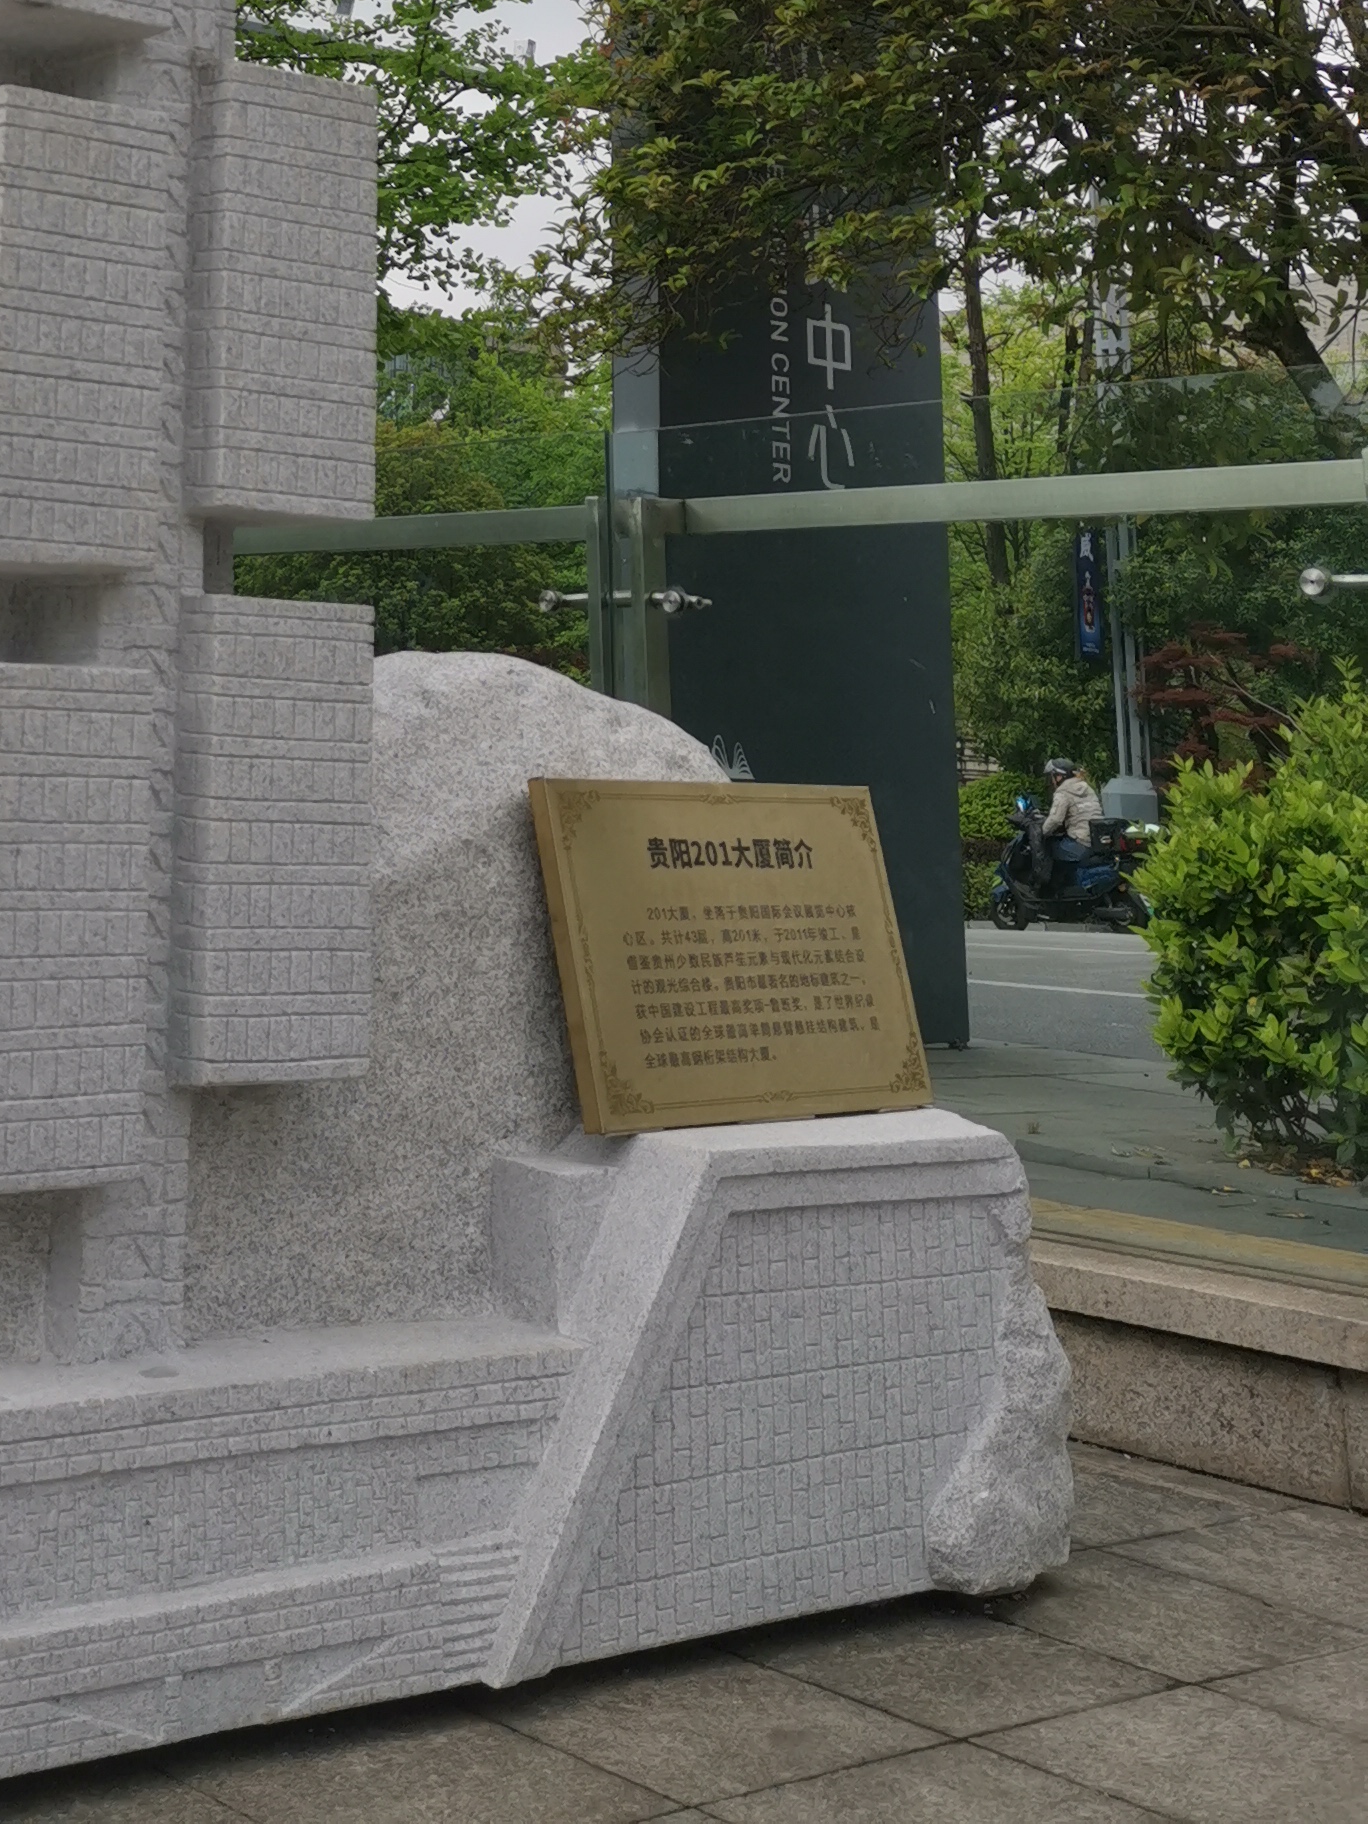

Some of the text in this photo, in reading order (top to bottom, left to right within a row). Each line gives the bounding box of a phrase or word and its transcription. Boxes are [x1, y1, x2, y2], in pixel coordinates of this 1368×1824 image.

[771, 352, 792, 484] CENTER
[646, 836, 814, 870] 贵阳201大厦简介
